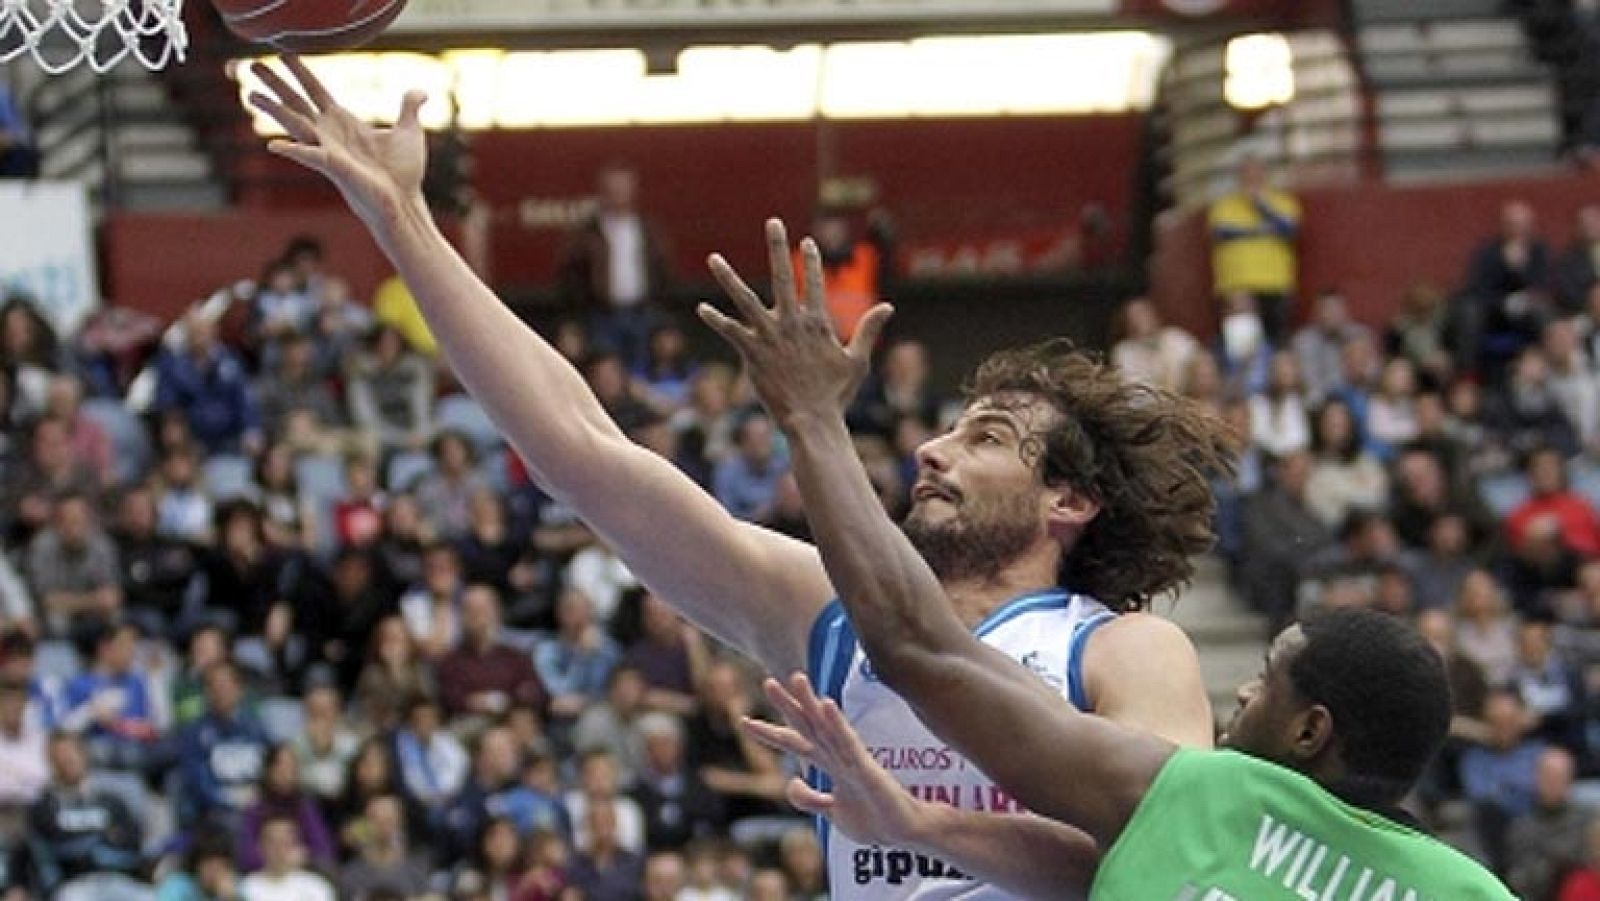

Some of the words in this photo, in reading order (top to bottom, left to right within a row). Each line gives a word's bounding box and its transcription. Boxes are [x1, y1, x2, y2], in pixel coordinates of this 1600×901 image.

[867, 747, 951, 770] GUROS
[853, 844, 975, 884] gipu
[1250, 814, 1418, 901] WILLIA
